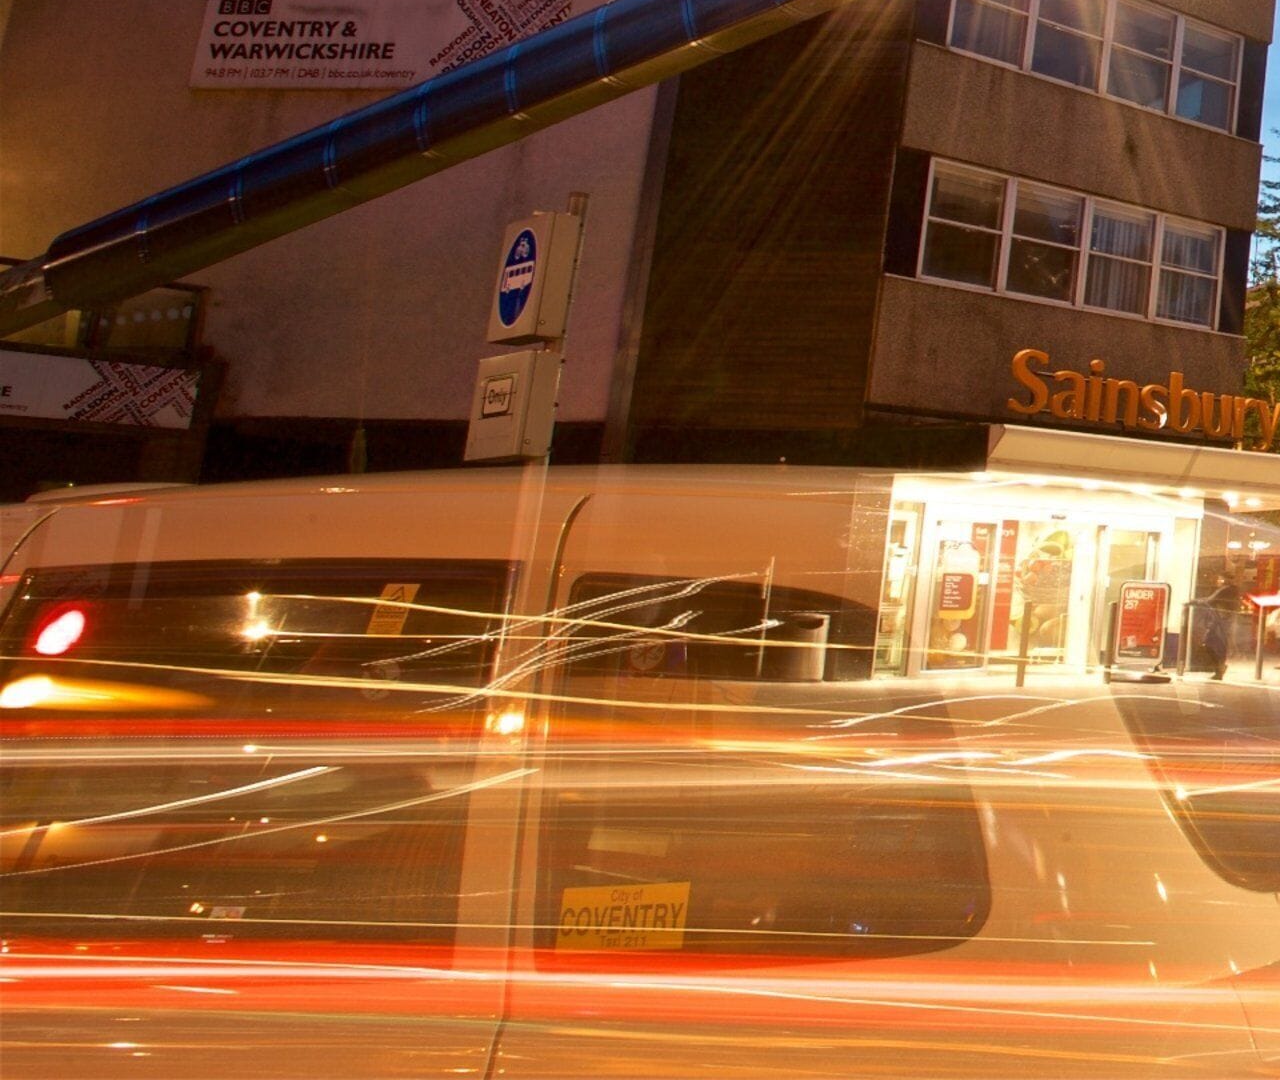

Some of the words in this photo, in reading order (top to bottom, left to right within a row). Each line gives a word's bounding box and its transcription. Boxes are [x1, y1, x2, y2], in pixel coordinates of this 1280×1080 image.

[218, 0, 272, 15] BBC
[213, 21, 338, 38] COVENTRY
[341, 21, 357, 37] &
[209, 43, 395, 60] WARWICKSHIRE
[429, 25, 476, 67] RADFORD
[297, 69, 320, 78] DAB
[488, 387, 508, 407] Only
[1124, 590, 1154, 601] UNDER
[611, 890, 630, 904] City
[633, 887, 644, 901] of
[560, 902, 684, 937] COVENTRY
